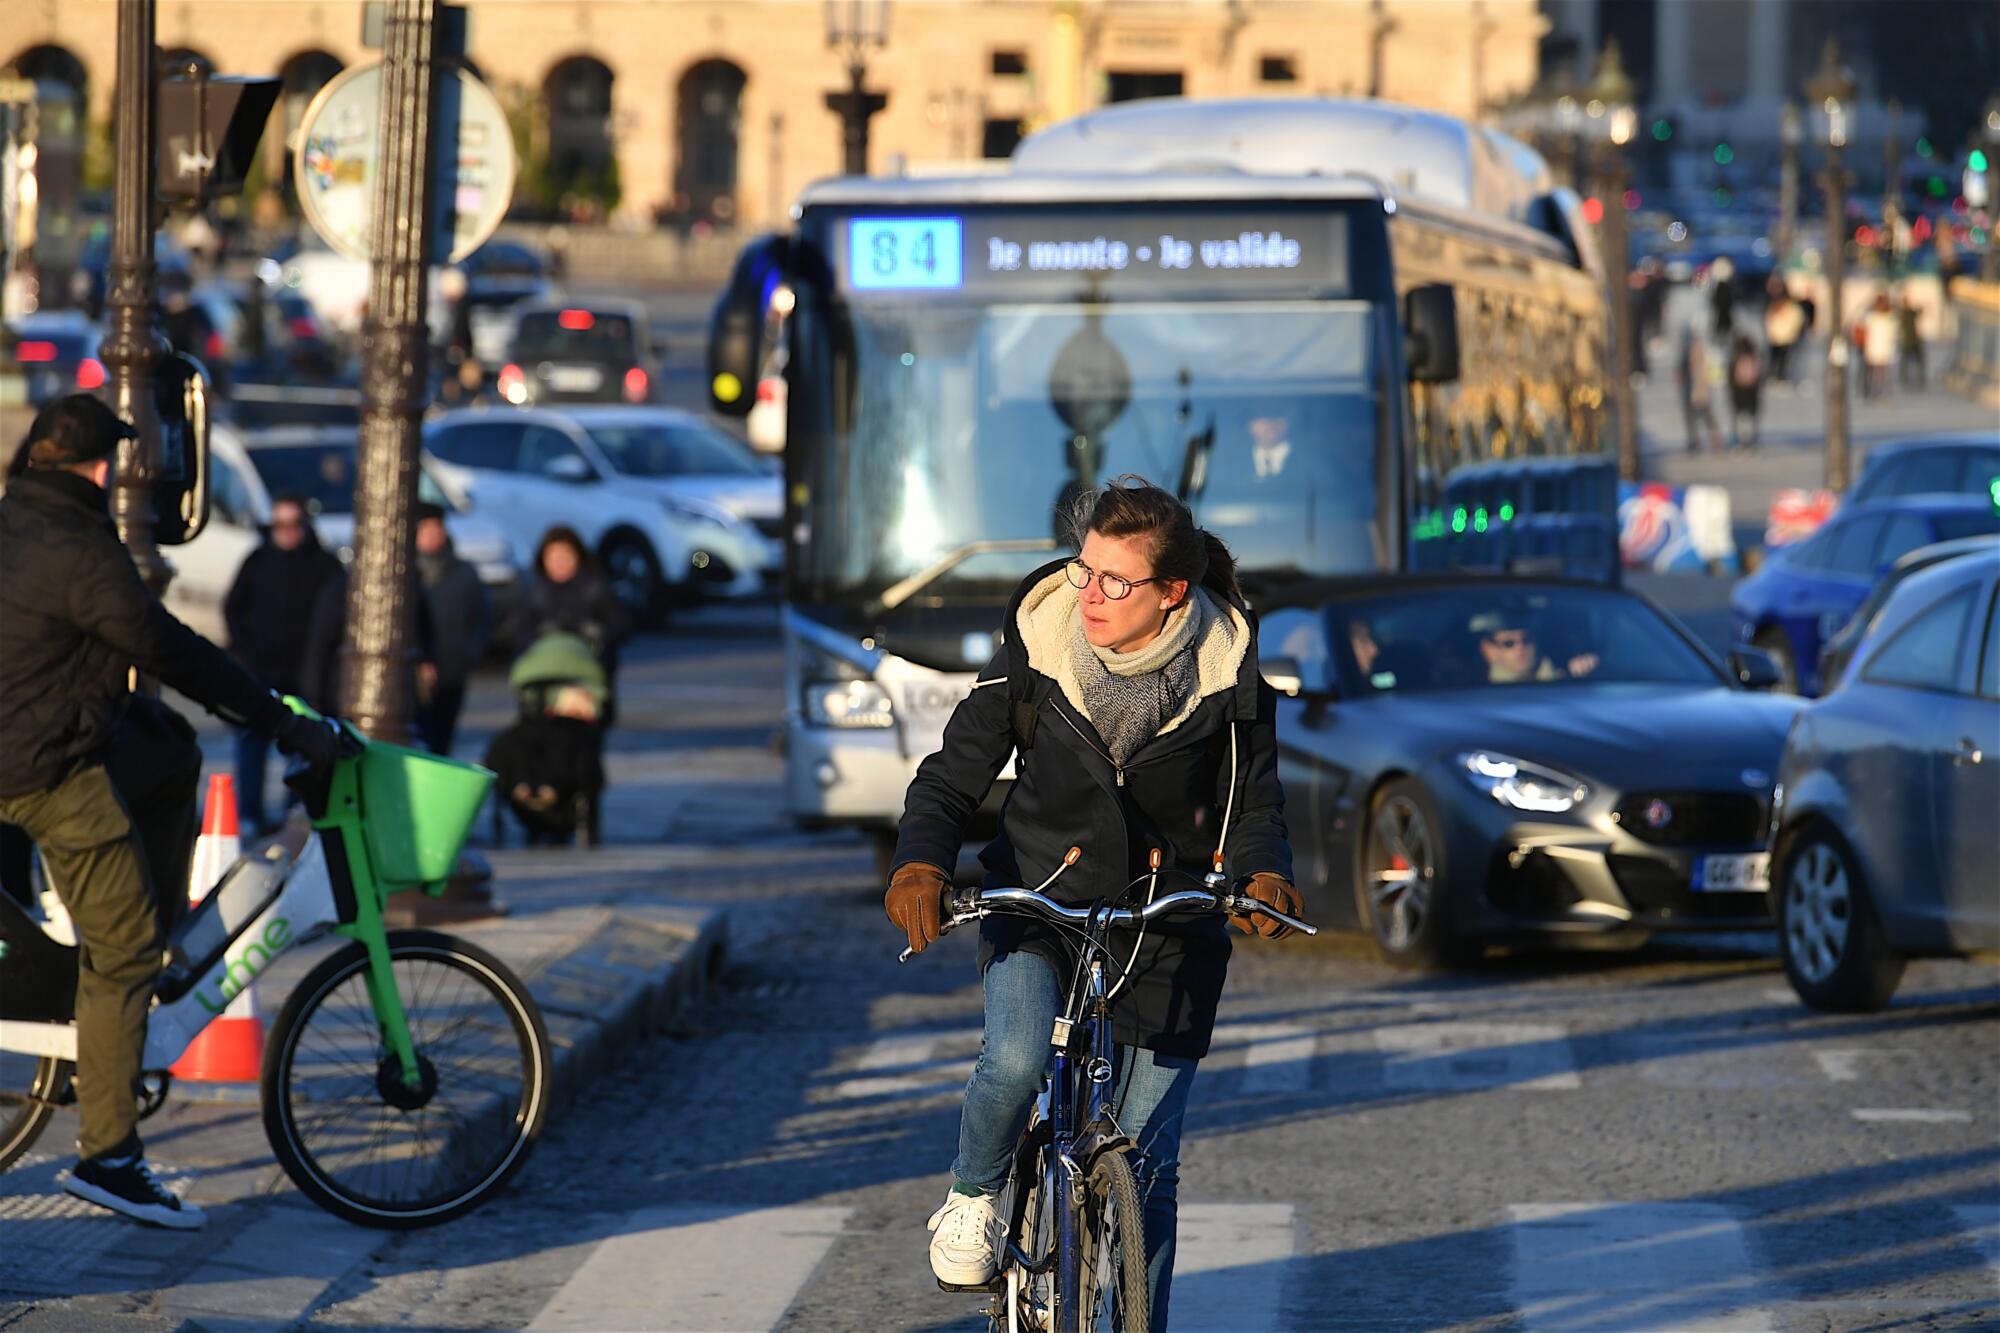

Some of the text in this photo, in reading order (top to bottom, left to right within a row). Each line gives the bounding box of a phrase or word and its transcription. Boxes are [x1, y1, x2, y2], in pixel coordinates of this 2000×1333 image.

[1028, 236, 1129, 271] monte
[1159, 233, 1193, 270] Je
[1200, 230, 1302, 268] valide
[195, 916, 294, 1012] Lime
